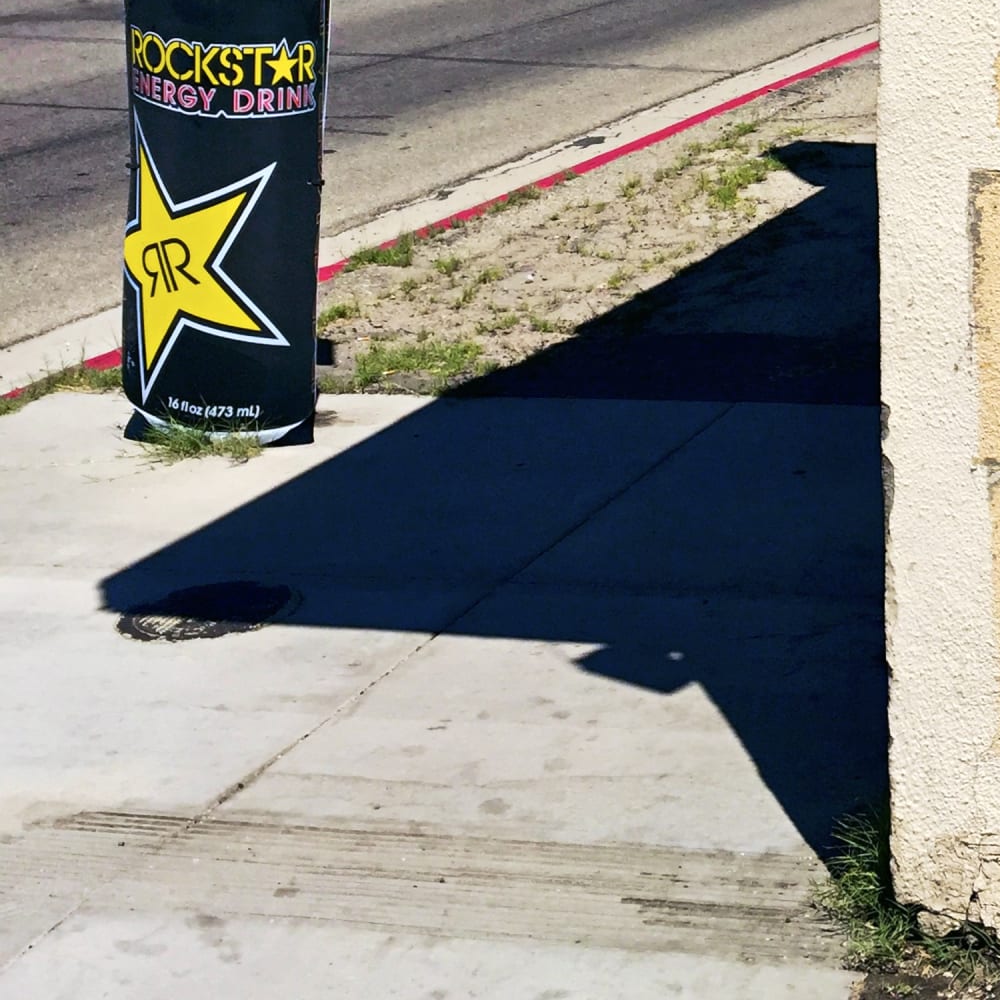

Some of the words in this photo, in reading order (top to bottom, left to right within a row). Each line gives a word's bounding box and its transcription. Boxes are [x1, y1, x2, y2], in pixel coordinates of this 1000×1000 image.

[133, 68, 217, 112] ENERGY
[232, 82, 316, 114] DRINK
[168, 396, 180, 410] 16
[204, 405, 234, 419] (473
[236, 404, 260, 419] mL)
